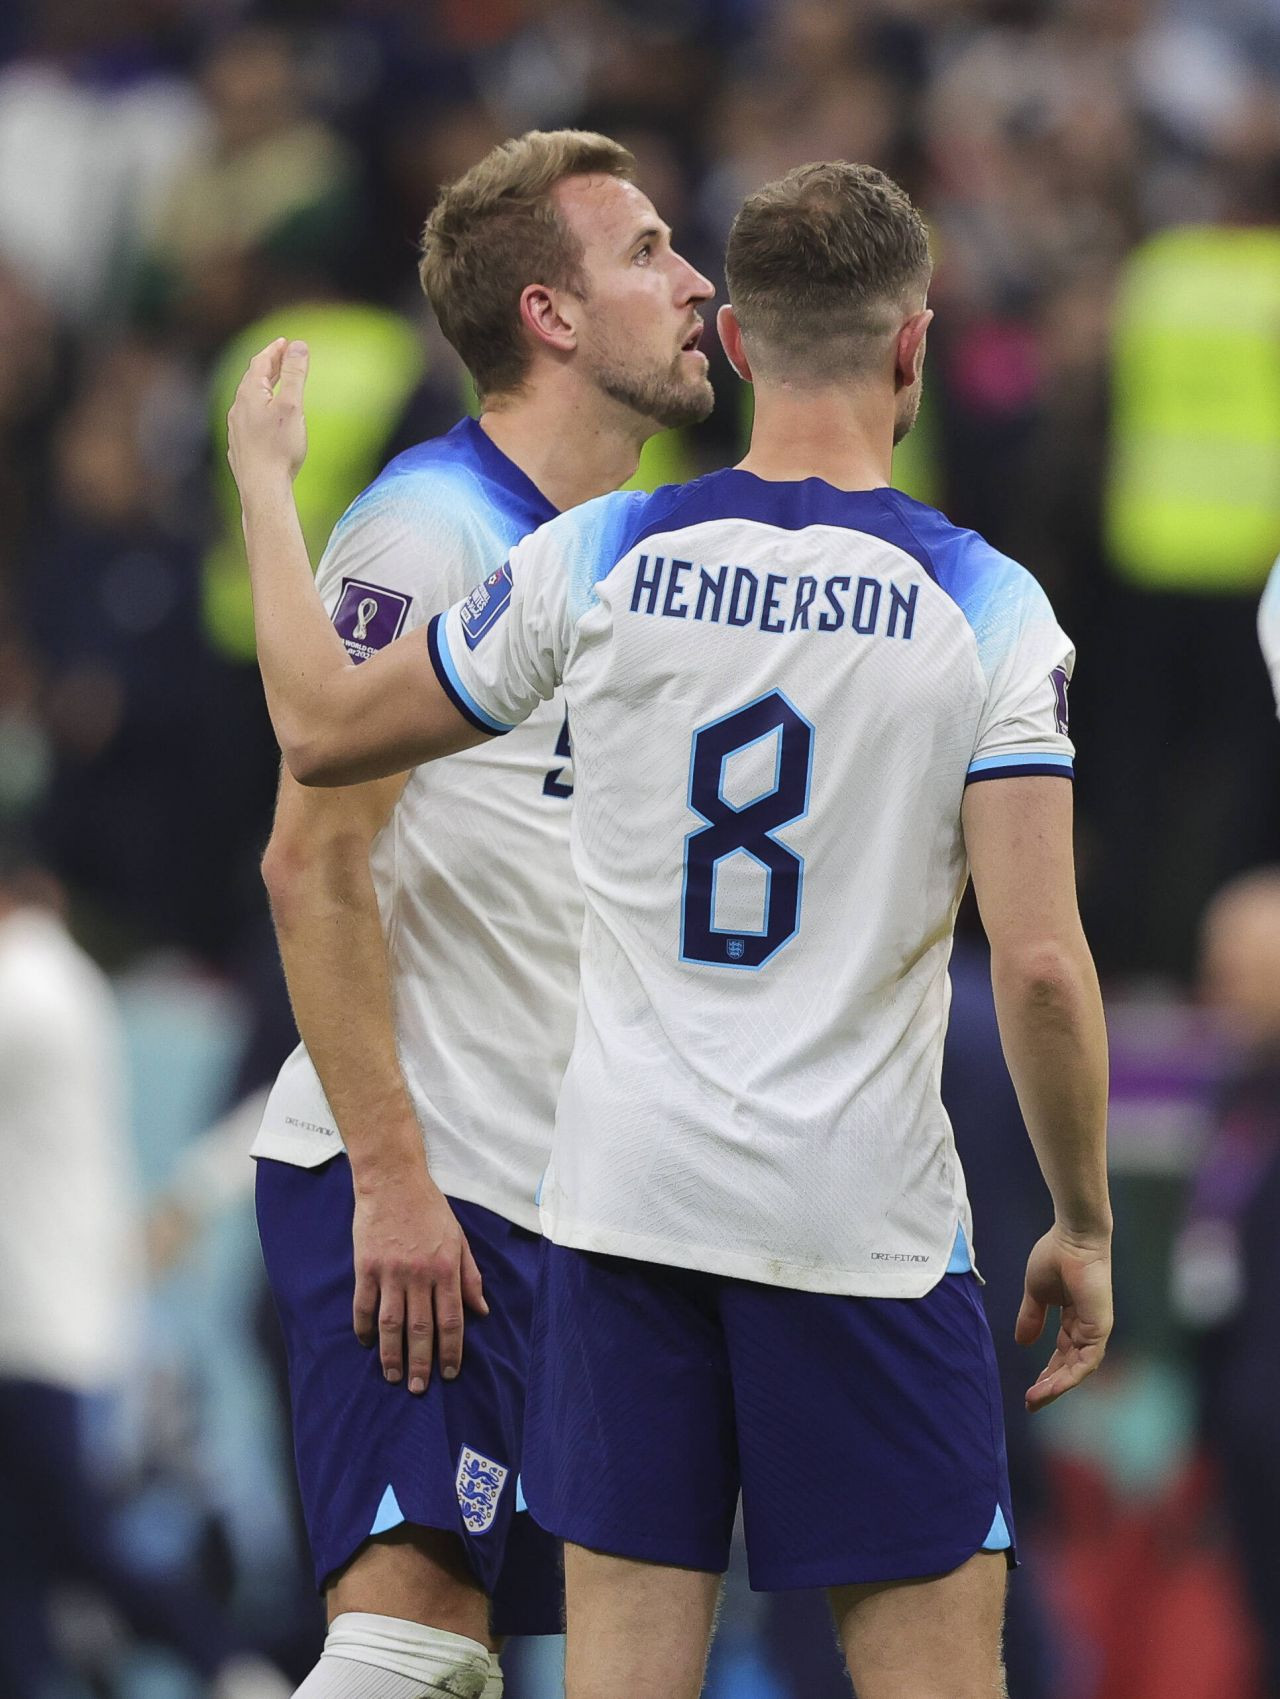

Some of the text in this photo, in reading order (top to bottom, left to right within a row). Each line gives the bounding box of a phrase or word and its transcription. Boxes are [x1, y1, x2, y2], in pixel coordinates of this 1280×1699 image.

[630, 554, 919, 640] HENDERSON
[345, 639, 367, 652] WORLD
[367, 646, 377, 655] CU
[678, 686, 816, 971] 8
